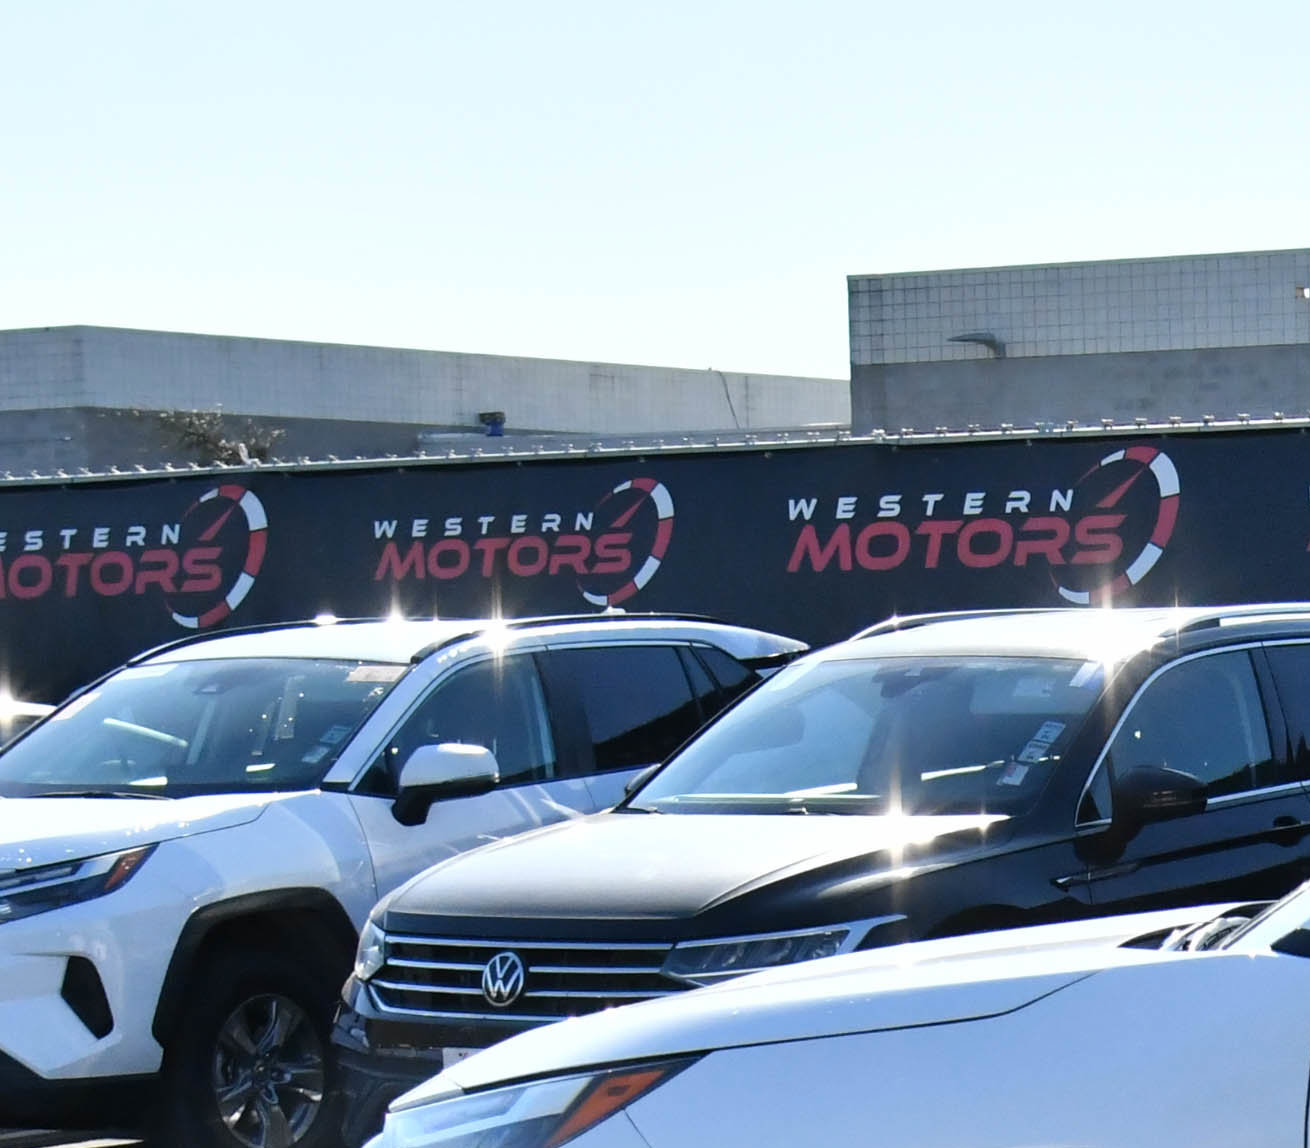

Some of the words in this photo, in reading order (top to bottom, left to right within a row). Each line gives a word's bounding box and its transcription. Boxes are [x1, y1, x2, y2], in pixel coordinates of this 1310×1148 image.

[374, 512, 594, 539] WESTERN
[788, 488, 1074, 521] WESTERN
[374, 533, 635, 581] MOTORS
[787, 514, 1126, 573] MOTORS
[0, 547, 223, 599] OTORS
